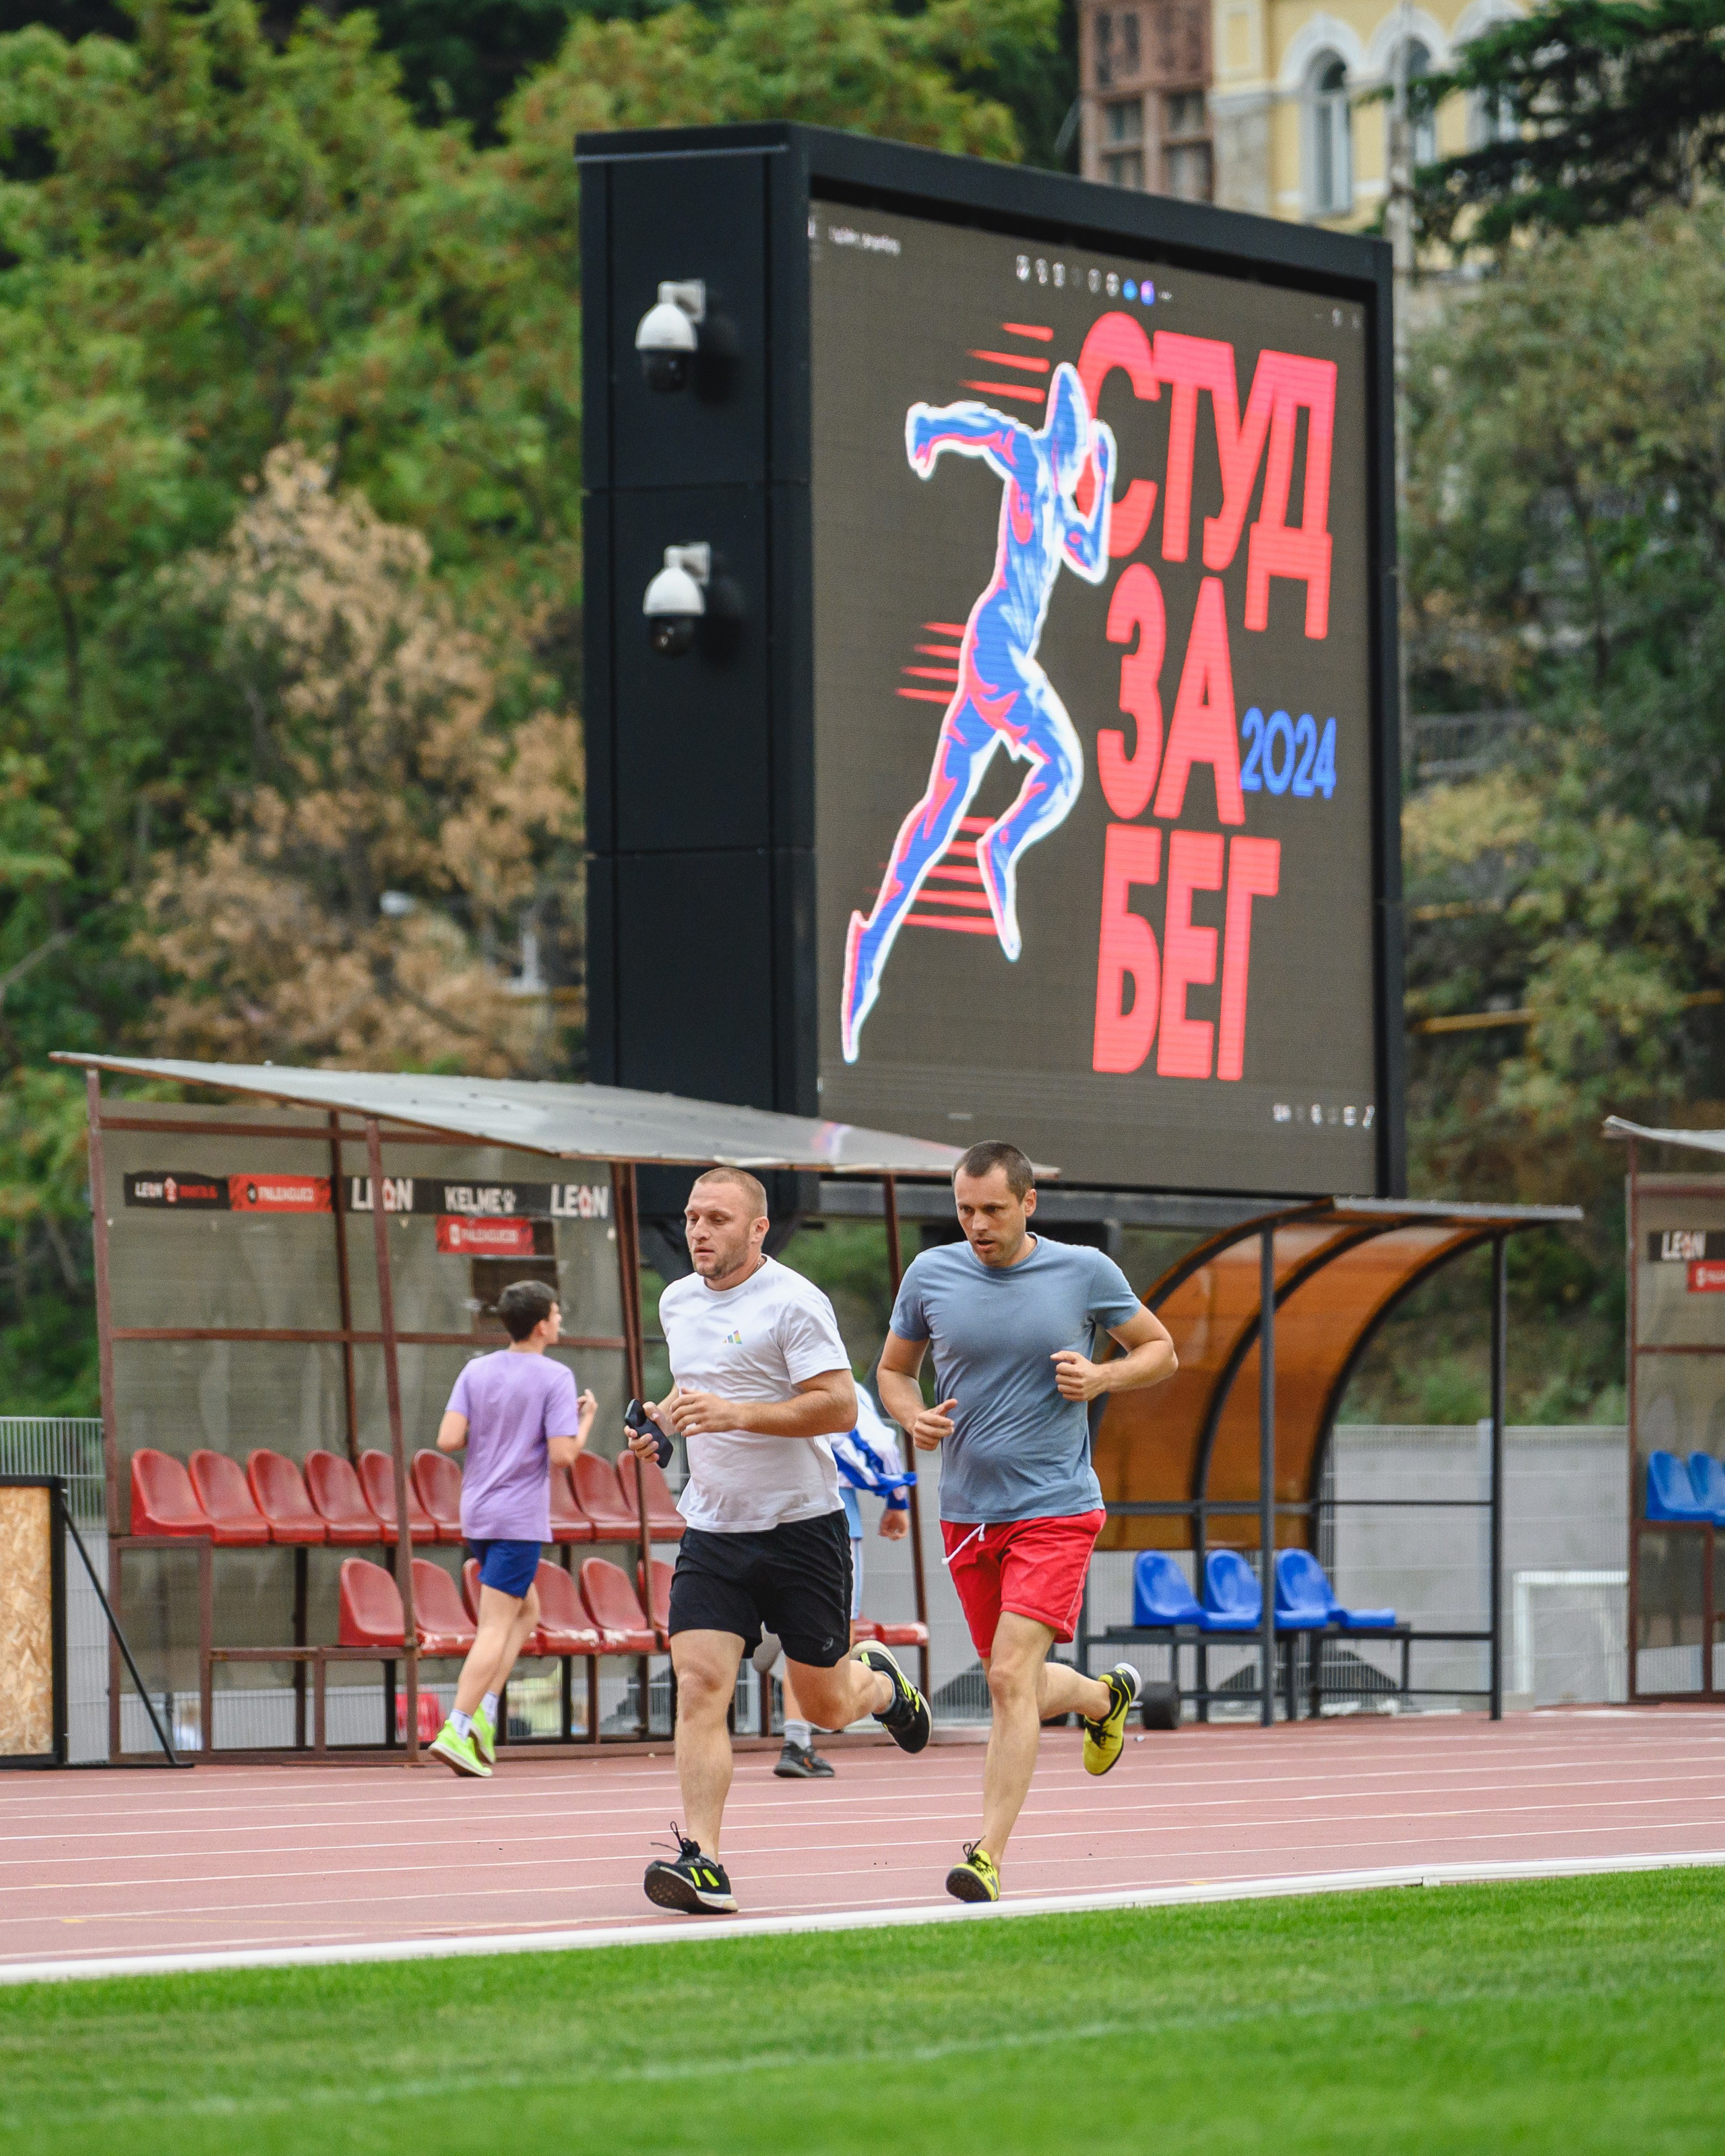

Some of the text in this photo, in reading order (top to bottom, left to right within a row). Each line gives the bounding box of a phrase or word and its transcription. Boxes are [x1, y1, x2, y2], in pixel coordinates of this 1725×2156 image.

[1076, 311, 1337, 640] СТУД
[1097, 563, 1245, 825] ЗА
[1241, 707, 1337, 800] 2024
[1092, 823, 1282, 1081] БЕГ
[444, 1186, 502, 1213] KELME
[550, 1183, 609, 1218] LEON
